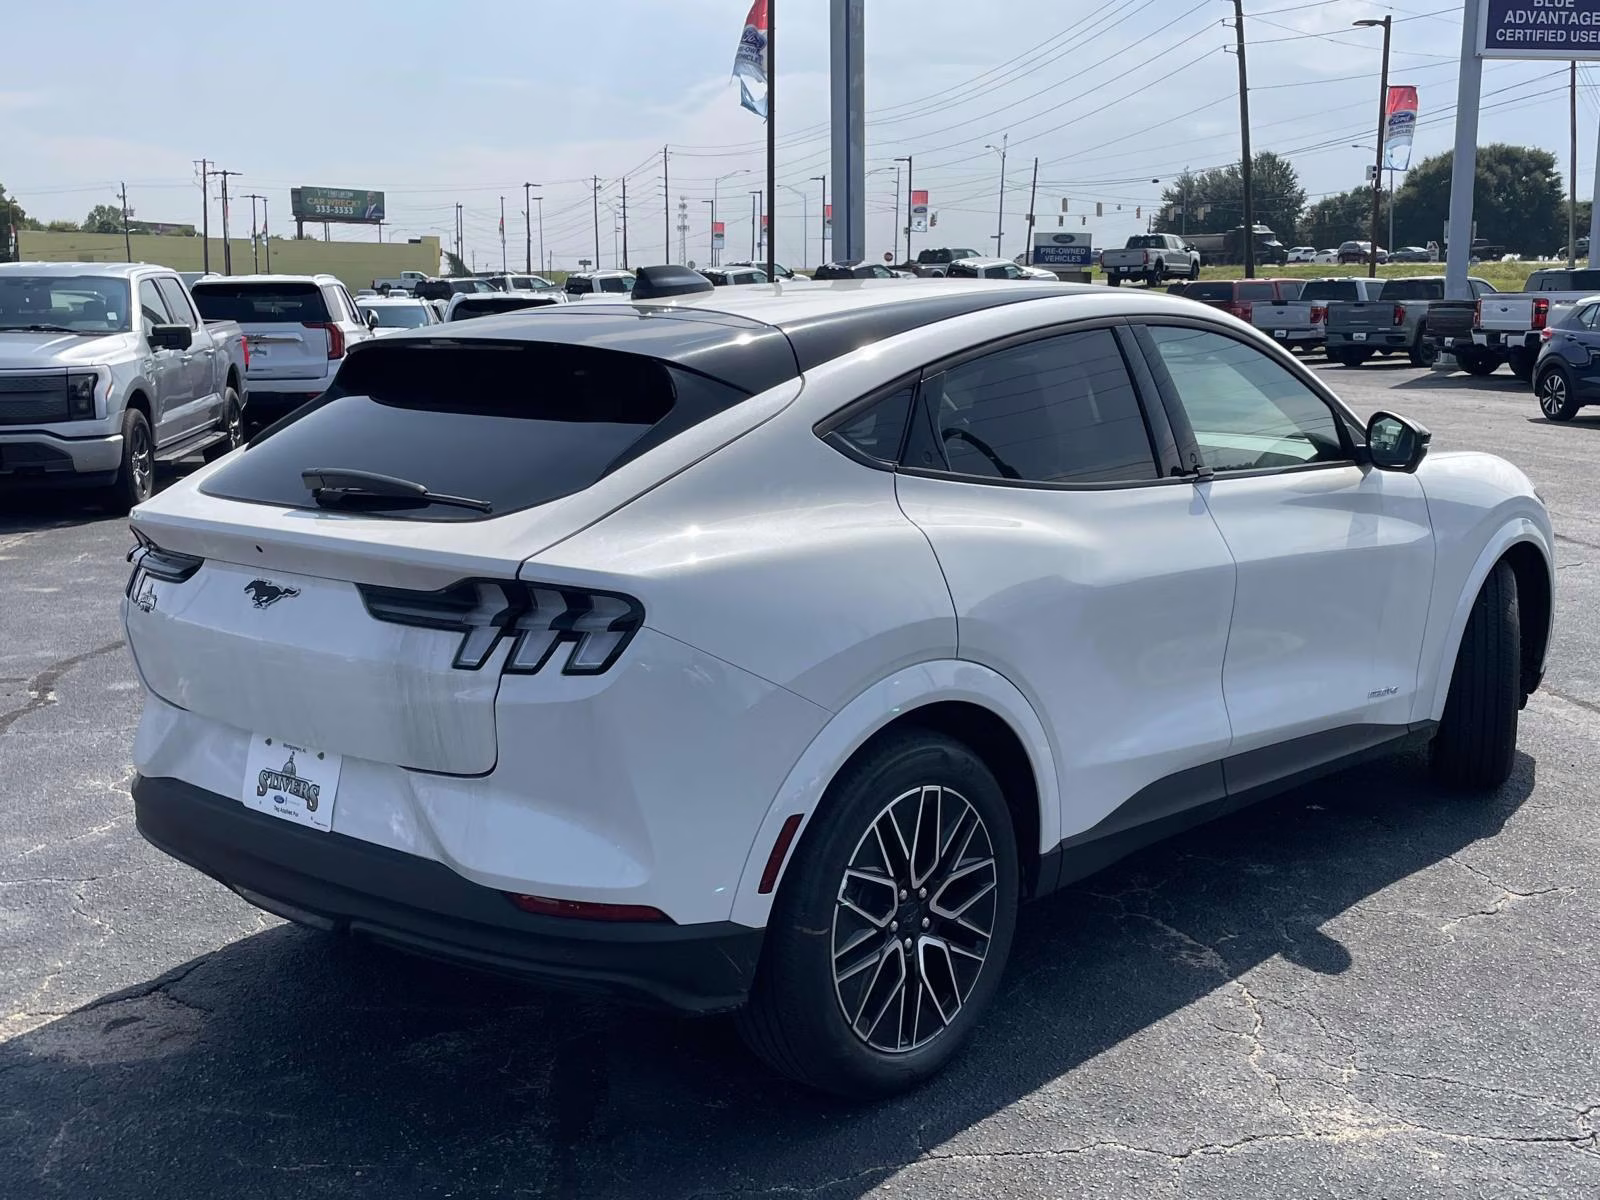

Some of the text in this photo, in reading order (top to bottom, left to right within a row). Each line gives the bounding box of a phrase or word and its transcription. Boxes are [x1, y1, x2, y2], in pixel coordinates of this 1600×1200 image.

[1503, 10, 1600, 25] ADVANTAGE
[1496, 28, 1566, 42] CERTIFIED
[316, 205, 353, 214] 333-3333
[1040, 247, 1086, 255] PRE-OWNED
[257, 769, 320, 812] STIVERS
